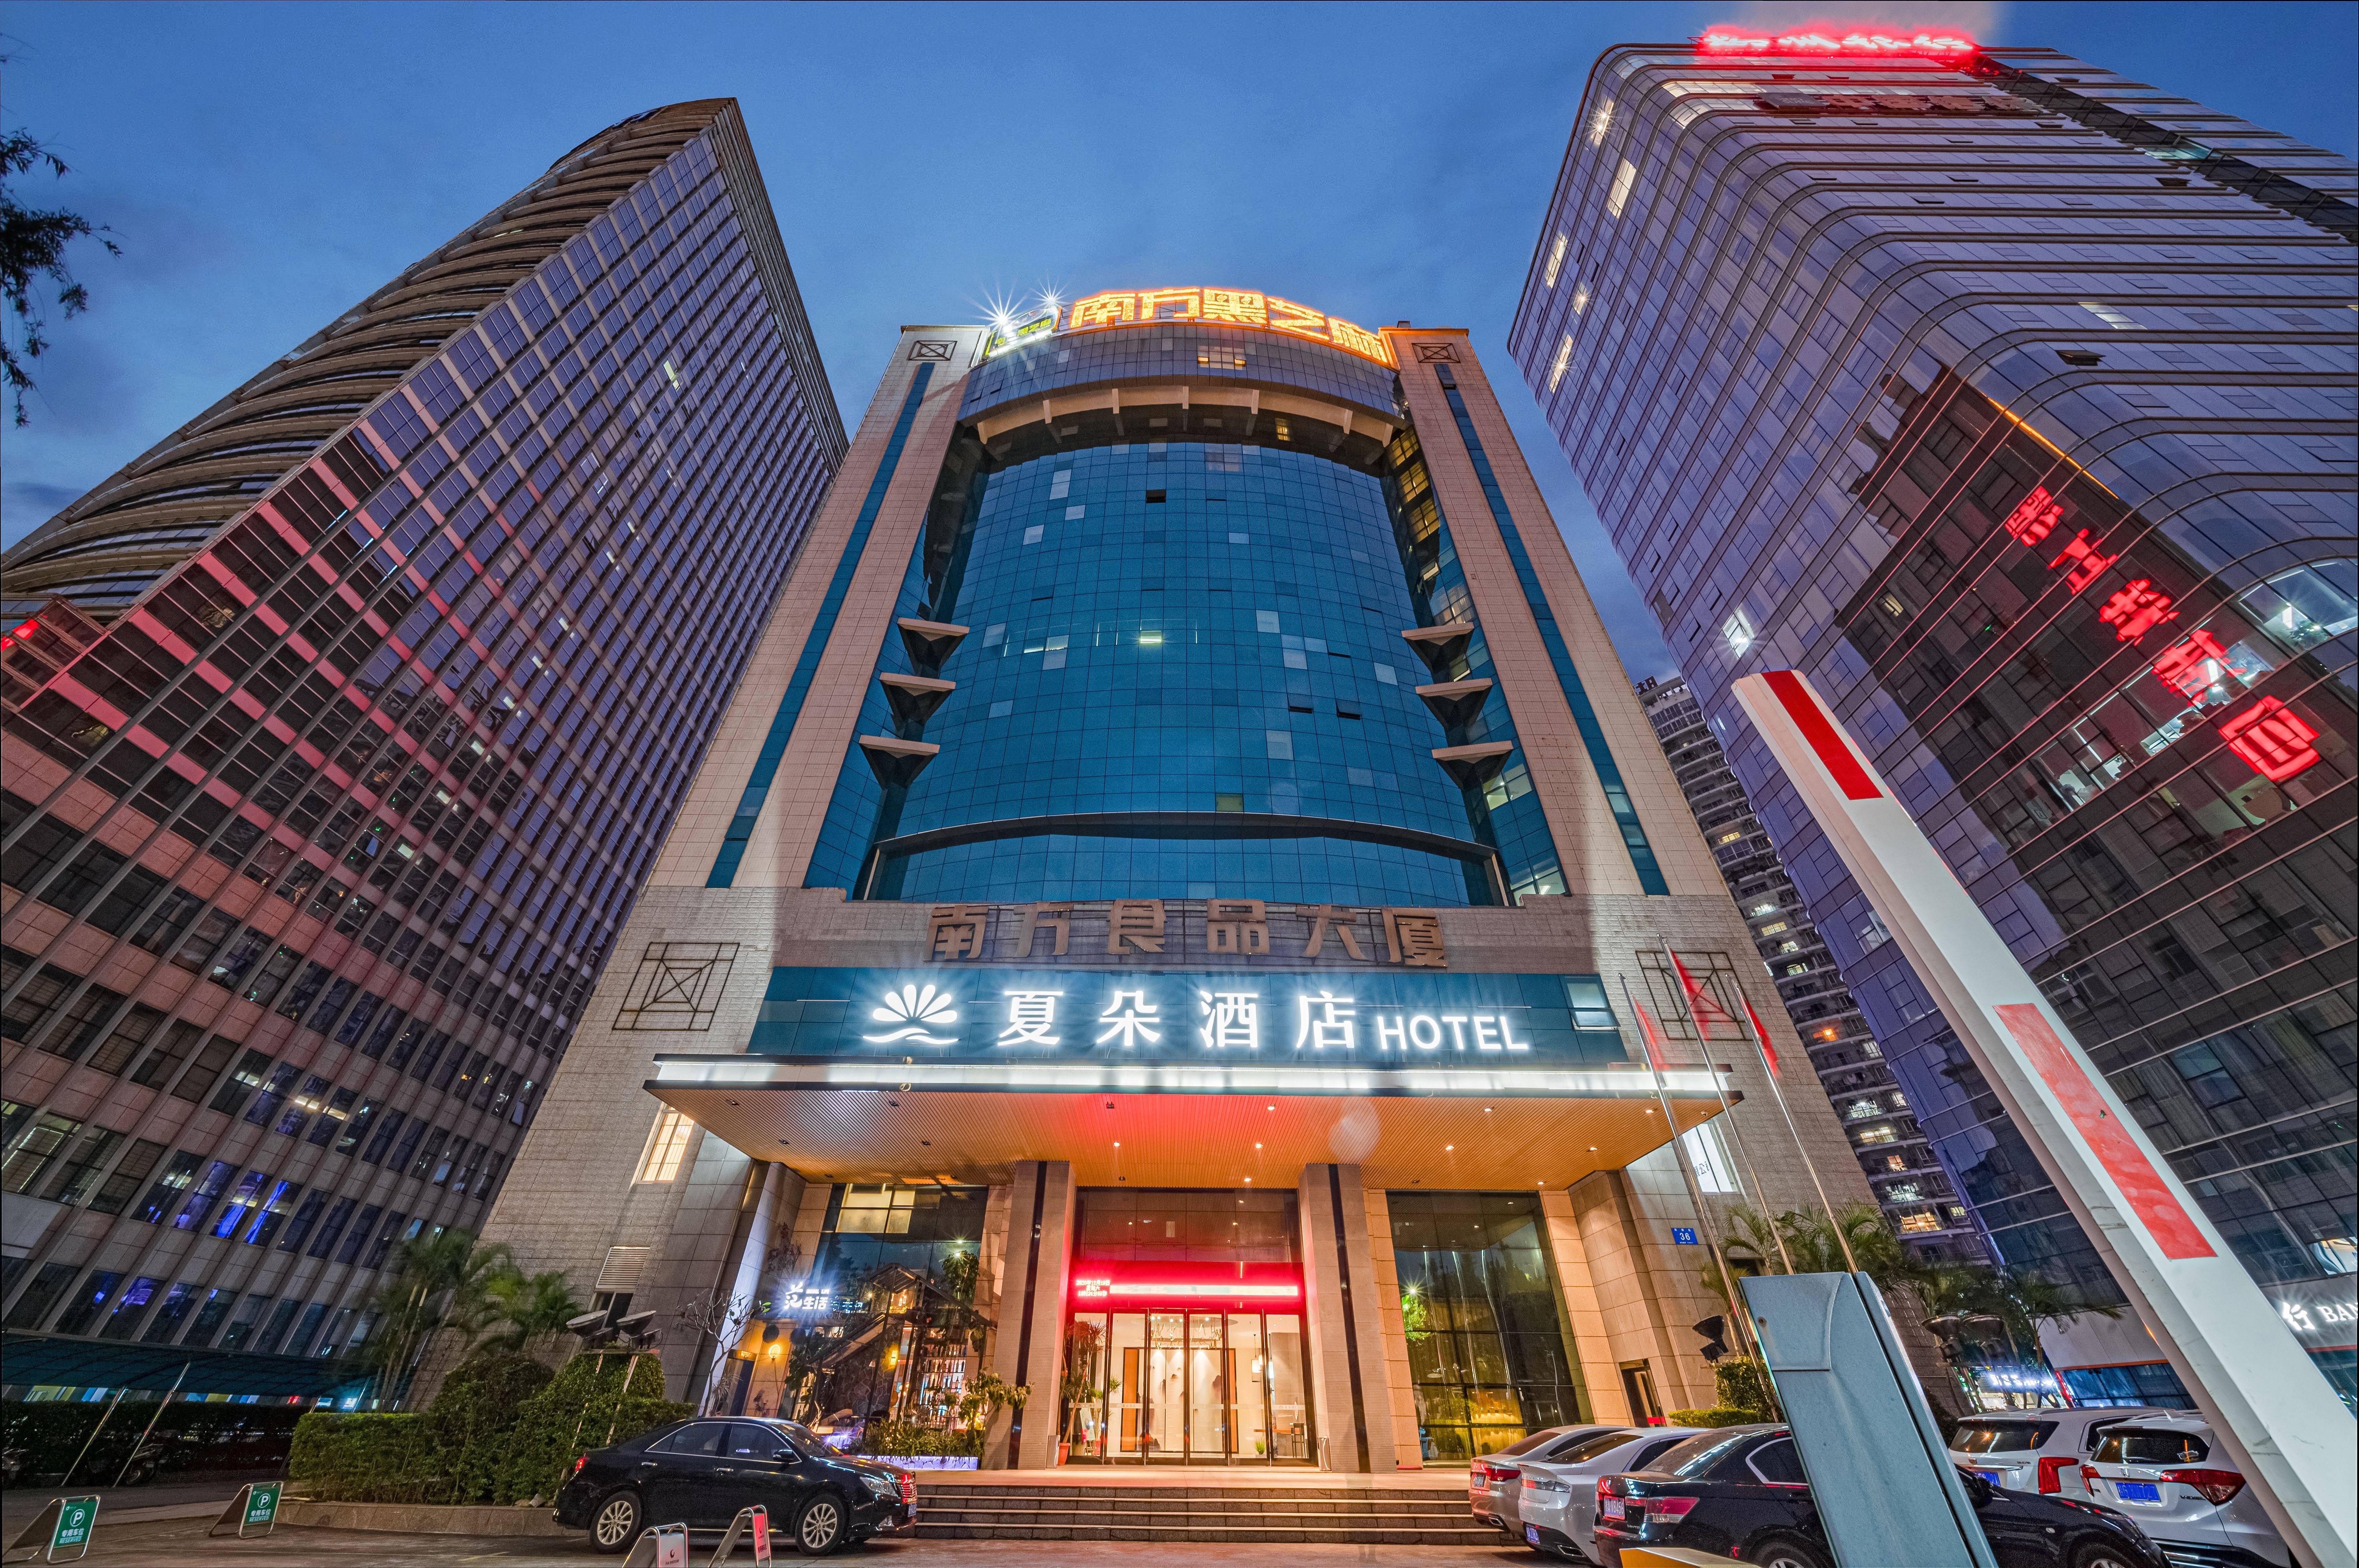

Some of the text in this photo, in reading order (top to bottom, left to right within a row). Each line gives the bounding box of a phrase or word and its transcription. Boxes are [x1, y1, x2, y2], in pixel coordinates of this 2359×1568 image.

[1070, 287, 1388, 364] 南方黑芝麻
[925, 899, 1449, 969] 南方食品大厦
[997, 990, 1356, 1049] 夏朵酒店
[1377, 1015, 1529, 1051] HOTEL
[1679, 1232, 1691, 1241] 36
[260, 1496, 269, 1506] P
[72, 1512, 83, 1524] P
[251, 1508, 271, 1517] 专用车位
[62, 1528, 84, 1537] 专用车位
